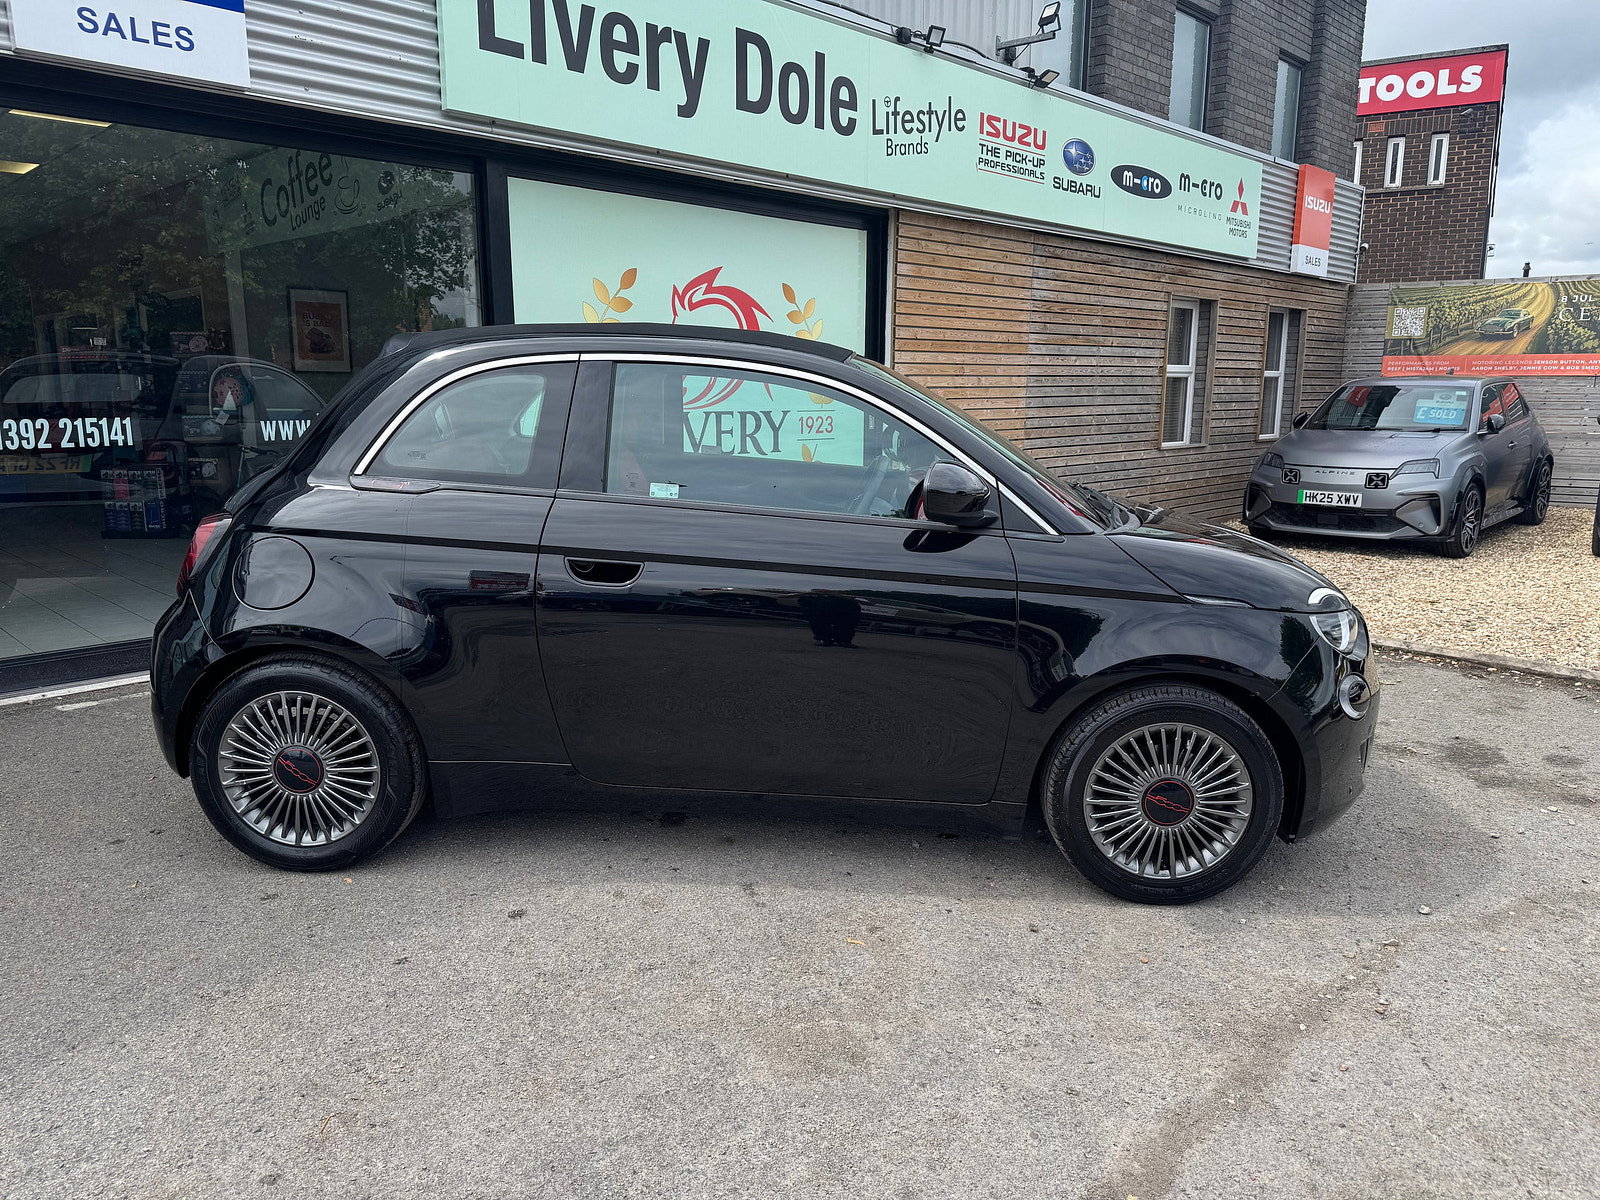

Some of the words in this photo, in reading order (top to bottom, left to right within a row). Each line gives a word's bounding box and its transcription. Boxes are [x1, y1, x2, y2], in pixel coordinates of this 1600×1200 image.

[76, 6, 195, 52] SALES
[478, 0, 711, 117] Livery
[735, 27, 858, 136] Dole
[1358, 65, 1484, 104] TOOLS
[871, 95, 967, 142] Lifestyle
[979, 112, 1047, 150] ISUZU
[886, 136, 929, 157] Brands
[979, 143, 1001, 158] THE
[1005, 149, 1046, 169] PICK-UP
[978, 157, 1045, 180] PROFESSIONALS
[260, 149, 333, 227] Coffee
[1052, 176, 1101, 198] SUBARU
[290, 196, 326, 231] Lounge
[1304, 195, 1331, 214] ISUZU
[1225, 216, 1252, 230] MITSUBISHI
[1228, 227, 1248, 239] MOTORS
[1305, 255, 1321, 267] SALES
[1561, 295, 1568, 303] 8
[1572, 294, 1596, 303] JUL
[1429, 409, 1457, 419] SOLD
[58, 417, 134, 448] 215141
[798, 416, 834, 435] 1923
[1304, 491, 1334, 504] HK25
[1336, 494, 1359, 505] XWV
